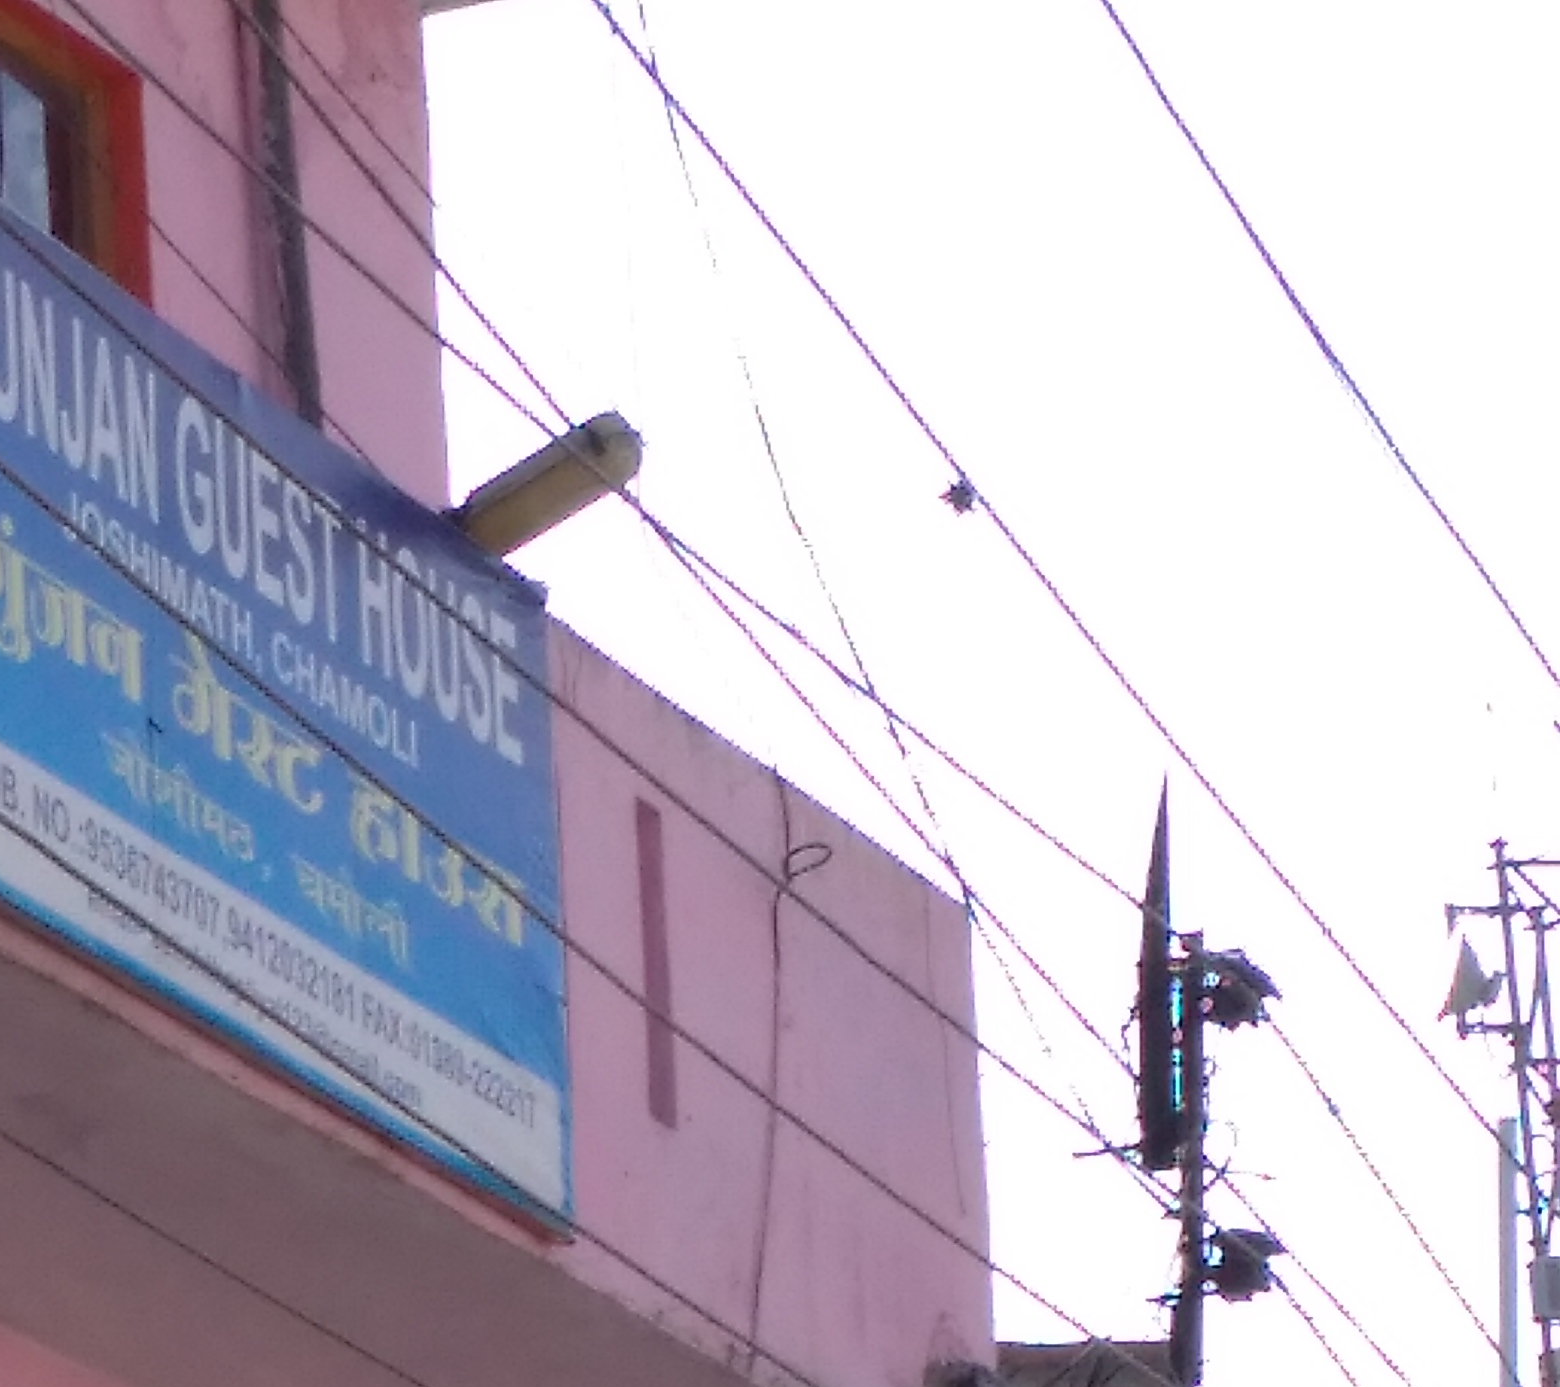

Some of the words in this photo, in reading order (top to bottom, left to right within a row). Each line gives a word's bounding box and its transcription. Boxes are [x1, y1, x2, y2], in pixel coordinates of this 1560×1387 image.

[176, 396, 342, 644] GUEST
[358, 516, 524, 765] HOUSE
[272, 631, 418, 768] CHAMOLI
[349, 768, 527, 947] हाउस
